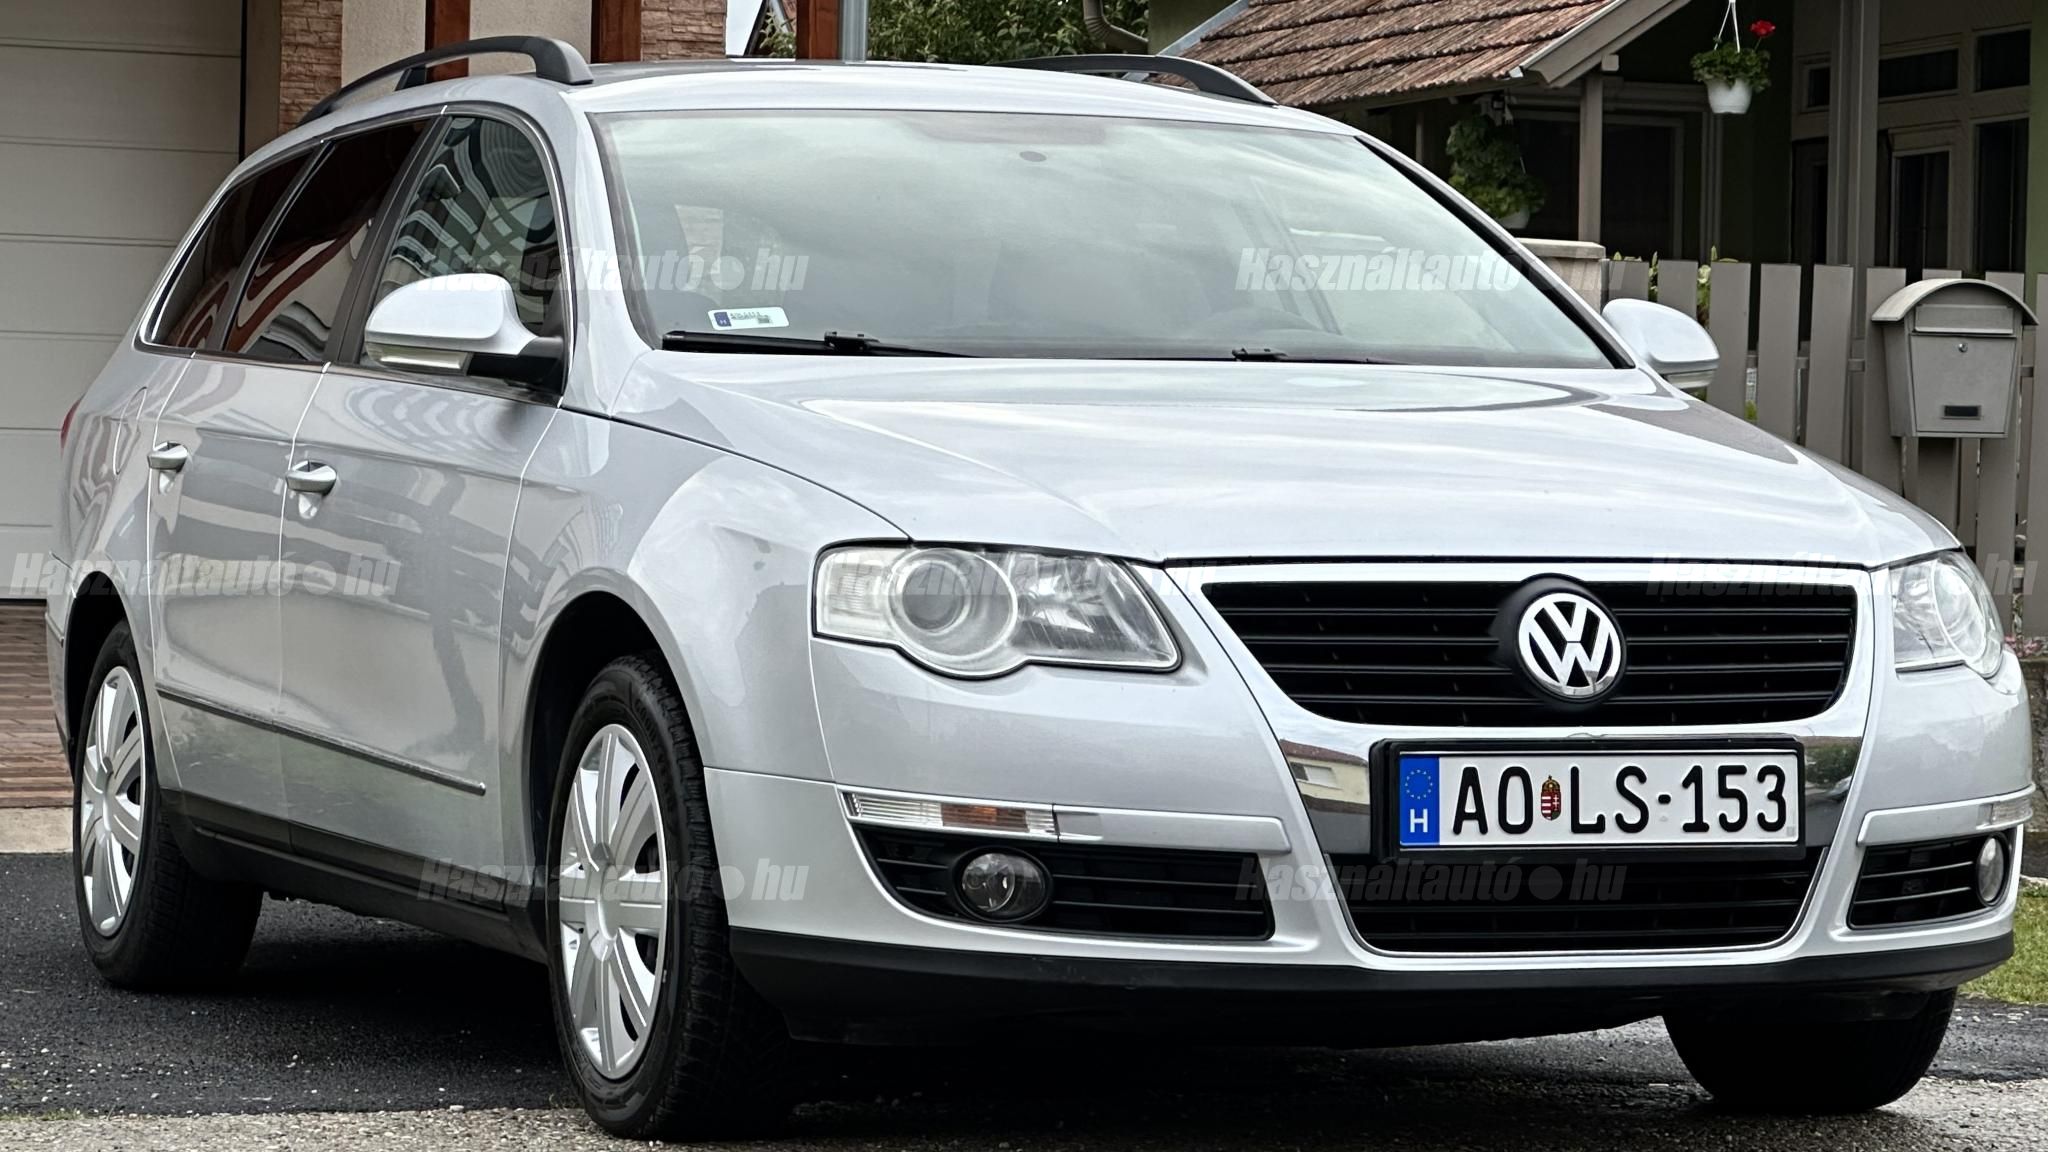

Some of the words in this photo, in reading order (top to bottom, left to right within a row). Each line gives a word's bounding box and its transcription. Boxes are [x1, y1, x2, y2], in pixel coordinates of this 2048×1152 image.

[1518, 592, 1622, 699] VW
[1409, 808, 1429, 833] H
[1452, 766, 1534, 835] AO
